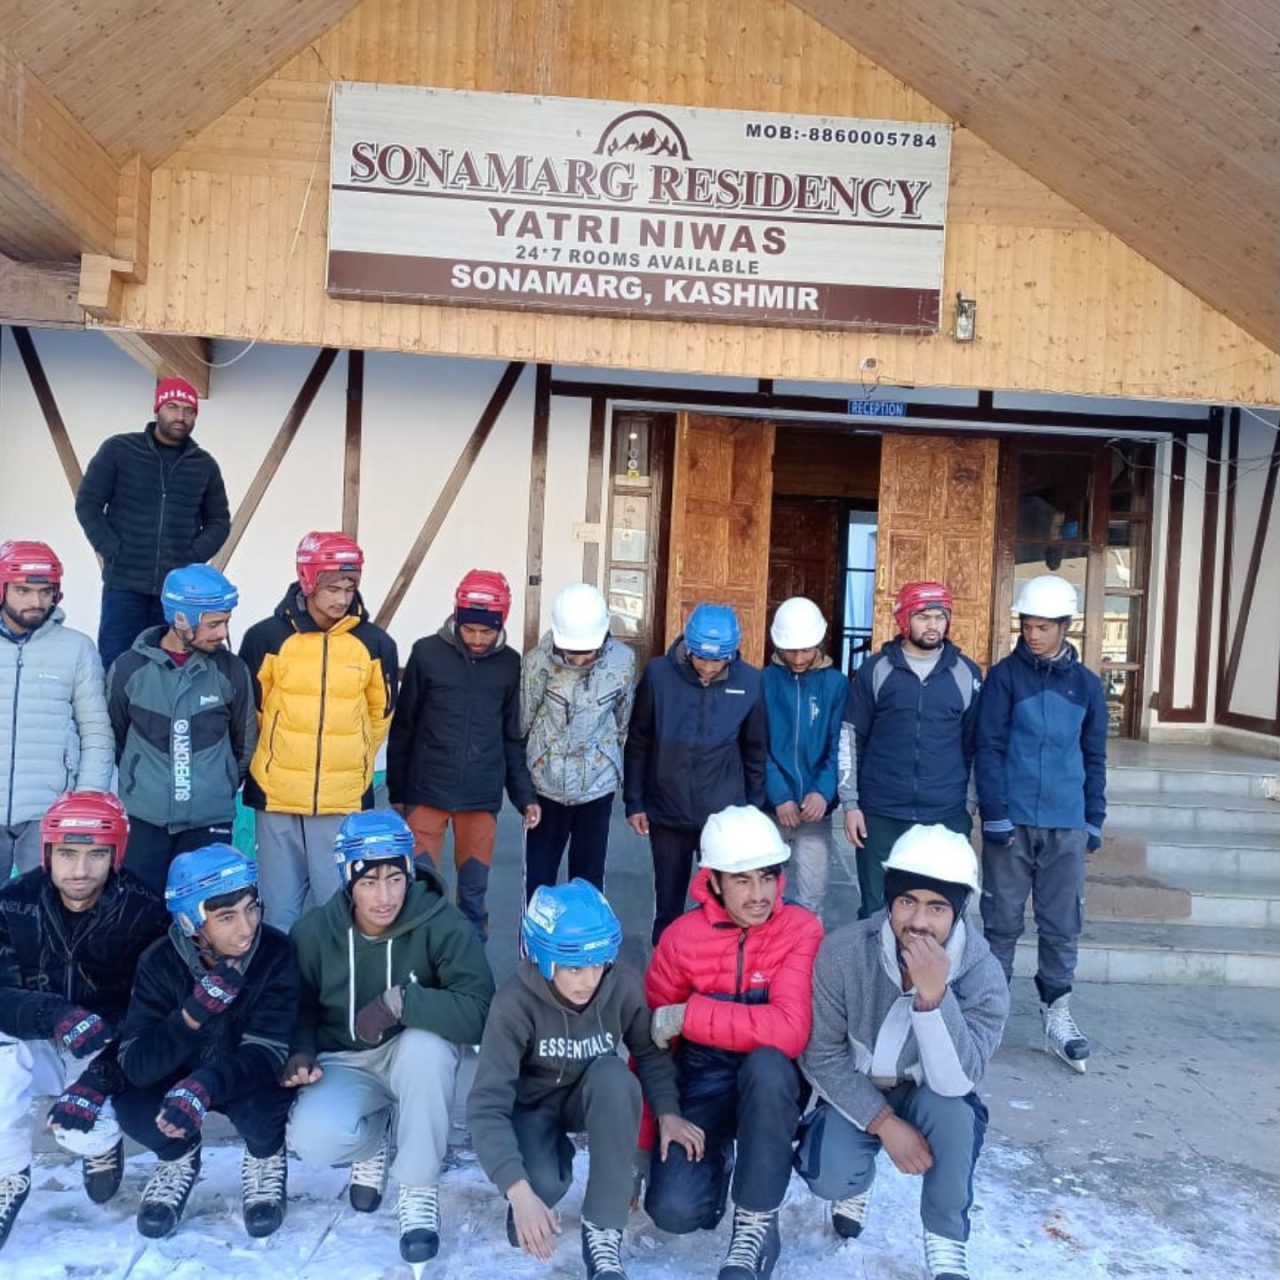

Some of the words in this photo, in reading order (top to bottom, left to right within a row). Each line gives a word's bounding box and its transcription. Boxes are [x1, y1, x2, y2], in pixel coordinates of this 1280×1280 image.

[746, 123, 937, 148] MOB:-8860005784
[350, 141, 638, 201] SONAMARG
[648, 164, 931, 219] RESIDENCY
[488, 207, 620, 245] YATRI
[639, 218, 787, 255] NIWAS
[568, 249, 640, 268] ROOMS
[647, 254, 760, 275] AVAILABLE
[450, 263, 653, 306] SONAMARG,
[664, 278, 820, 311] KASHMIR
[851, 401, 904, 416] RECEPTION
[539, 1031, 614, 1059] ESSENTIALS
